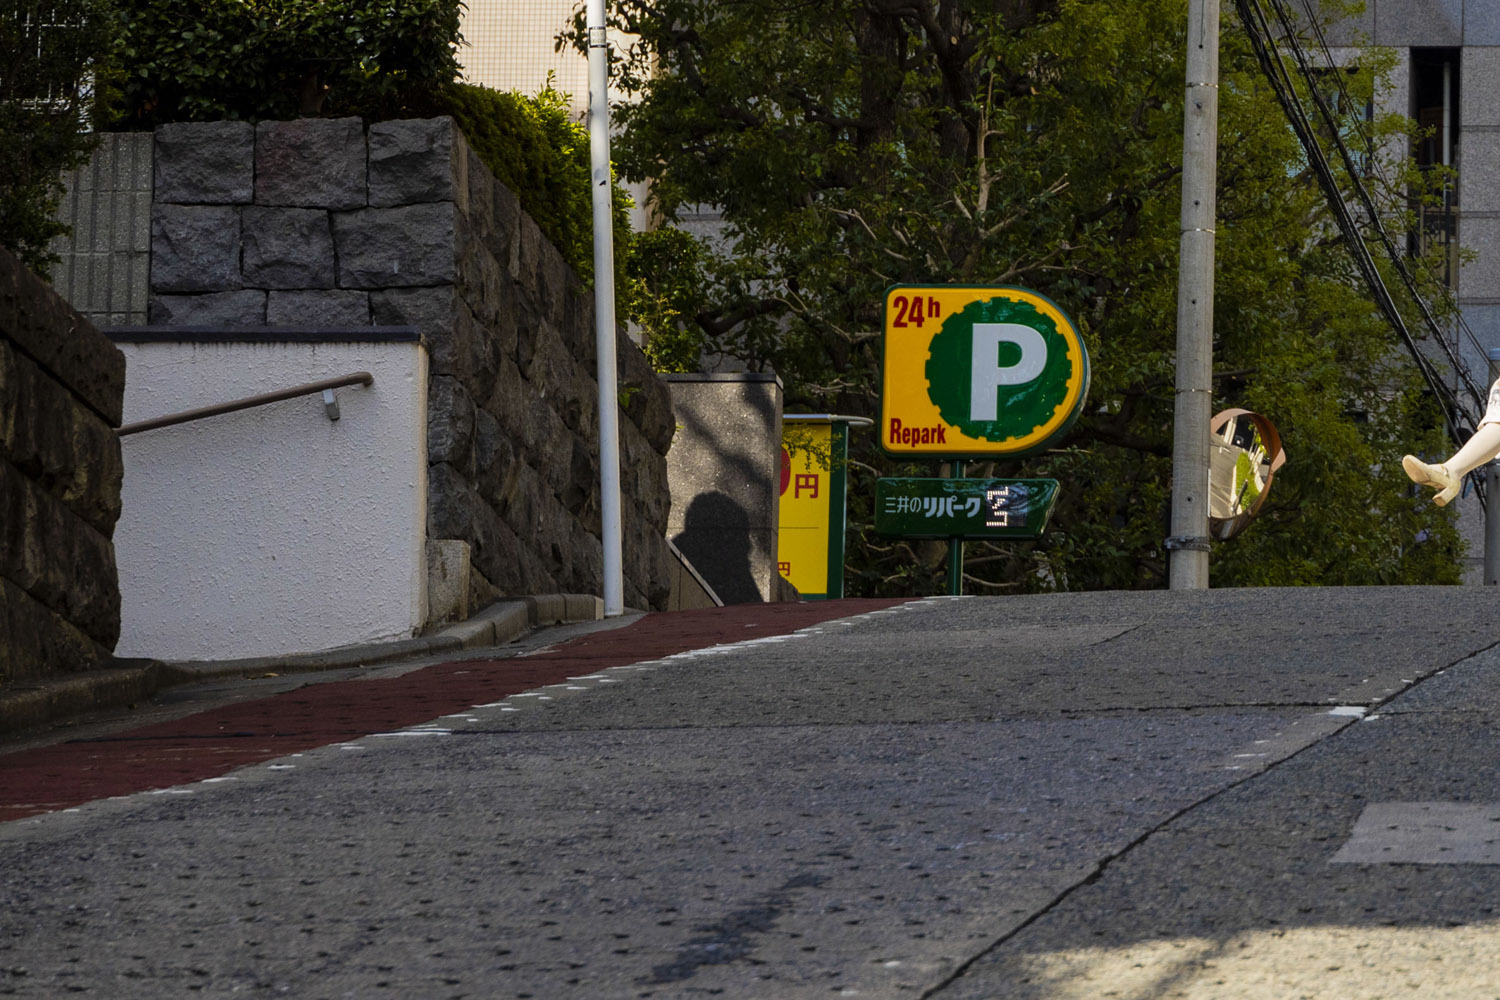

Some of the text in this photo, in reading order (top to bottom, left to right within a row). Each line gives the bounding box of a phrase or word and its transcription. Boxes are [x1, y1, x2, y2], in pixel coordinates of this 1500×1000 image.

[893, 295, 941, 329] 24h
[970, 322, 1048, 422] P
[889, 417, 946, 447] Repark
[885, 495, 981, 518] 三井のリパーク
